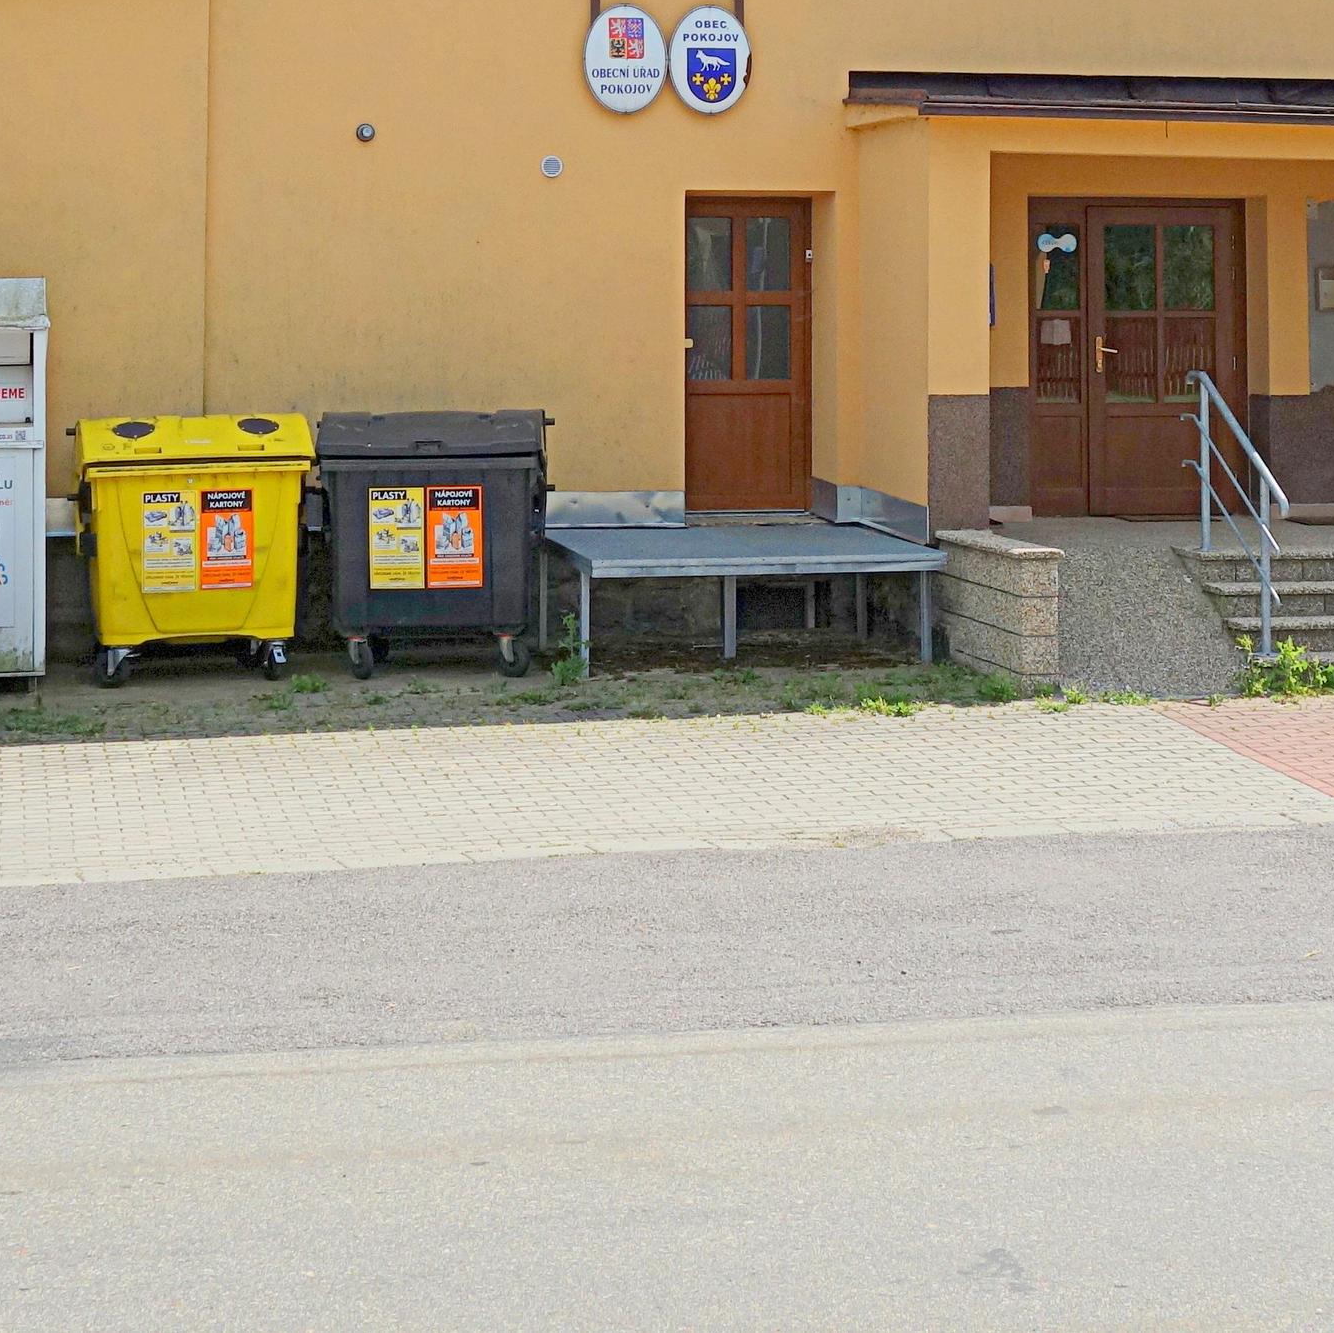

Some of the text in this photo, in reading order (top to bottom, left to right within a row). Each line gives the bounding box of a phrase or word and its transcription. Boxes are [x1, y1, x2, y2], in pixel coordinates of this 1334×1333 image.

[694, 20, 727, 29] OBEC
[682, 33, 739, 42] POKOJOV
[592, 65, 660, 78] OBECNÍ ÚŘAD
[600, 84, 652, 94] POKOJOV
[145, 493, 178, 503] PLASTY
[207, 491, 246, 500] NÁPOJOVÉ
[372, 491, 405, 500] PLASTY
[434, 489, 473, 498] NÁPOJOVÉ
[209, 500, 244, 508] KARTONY
